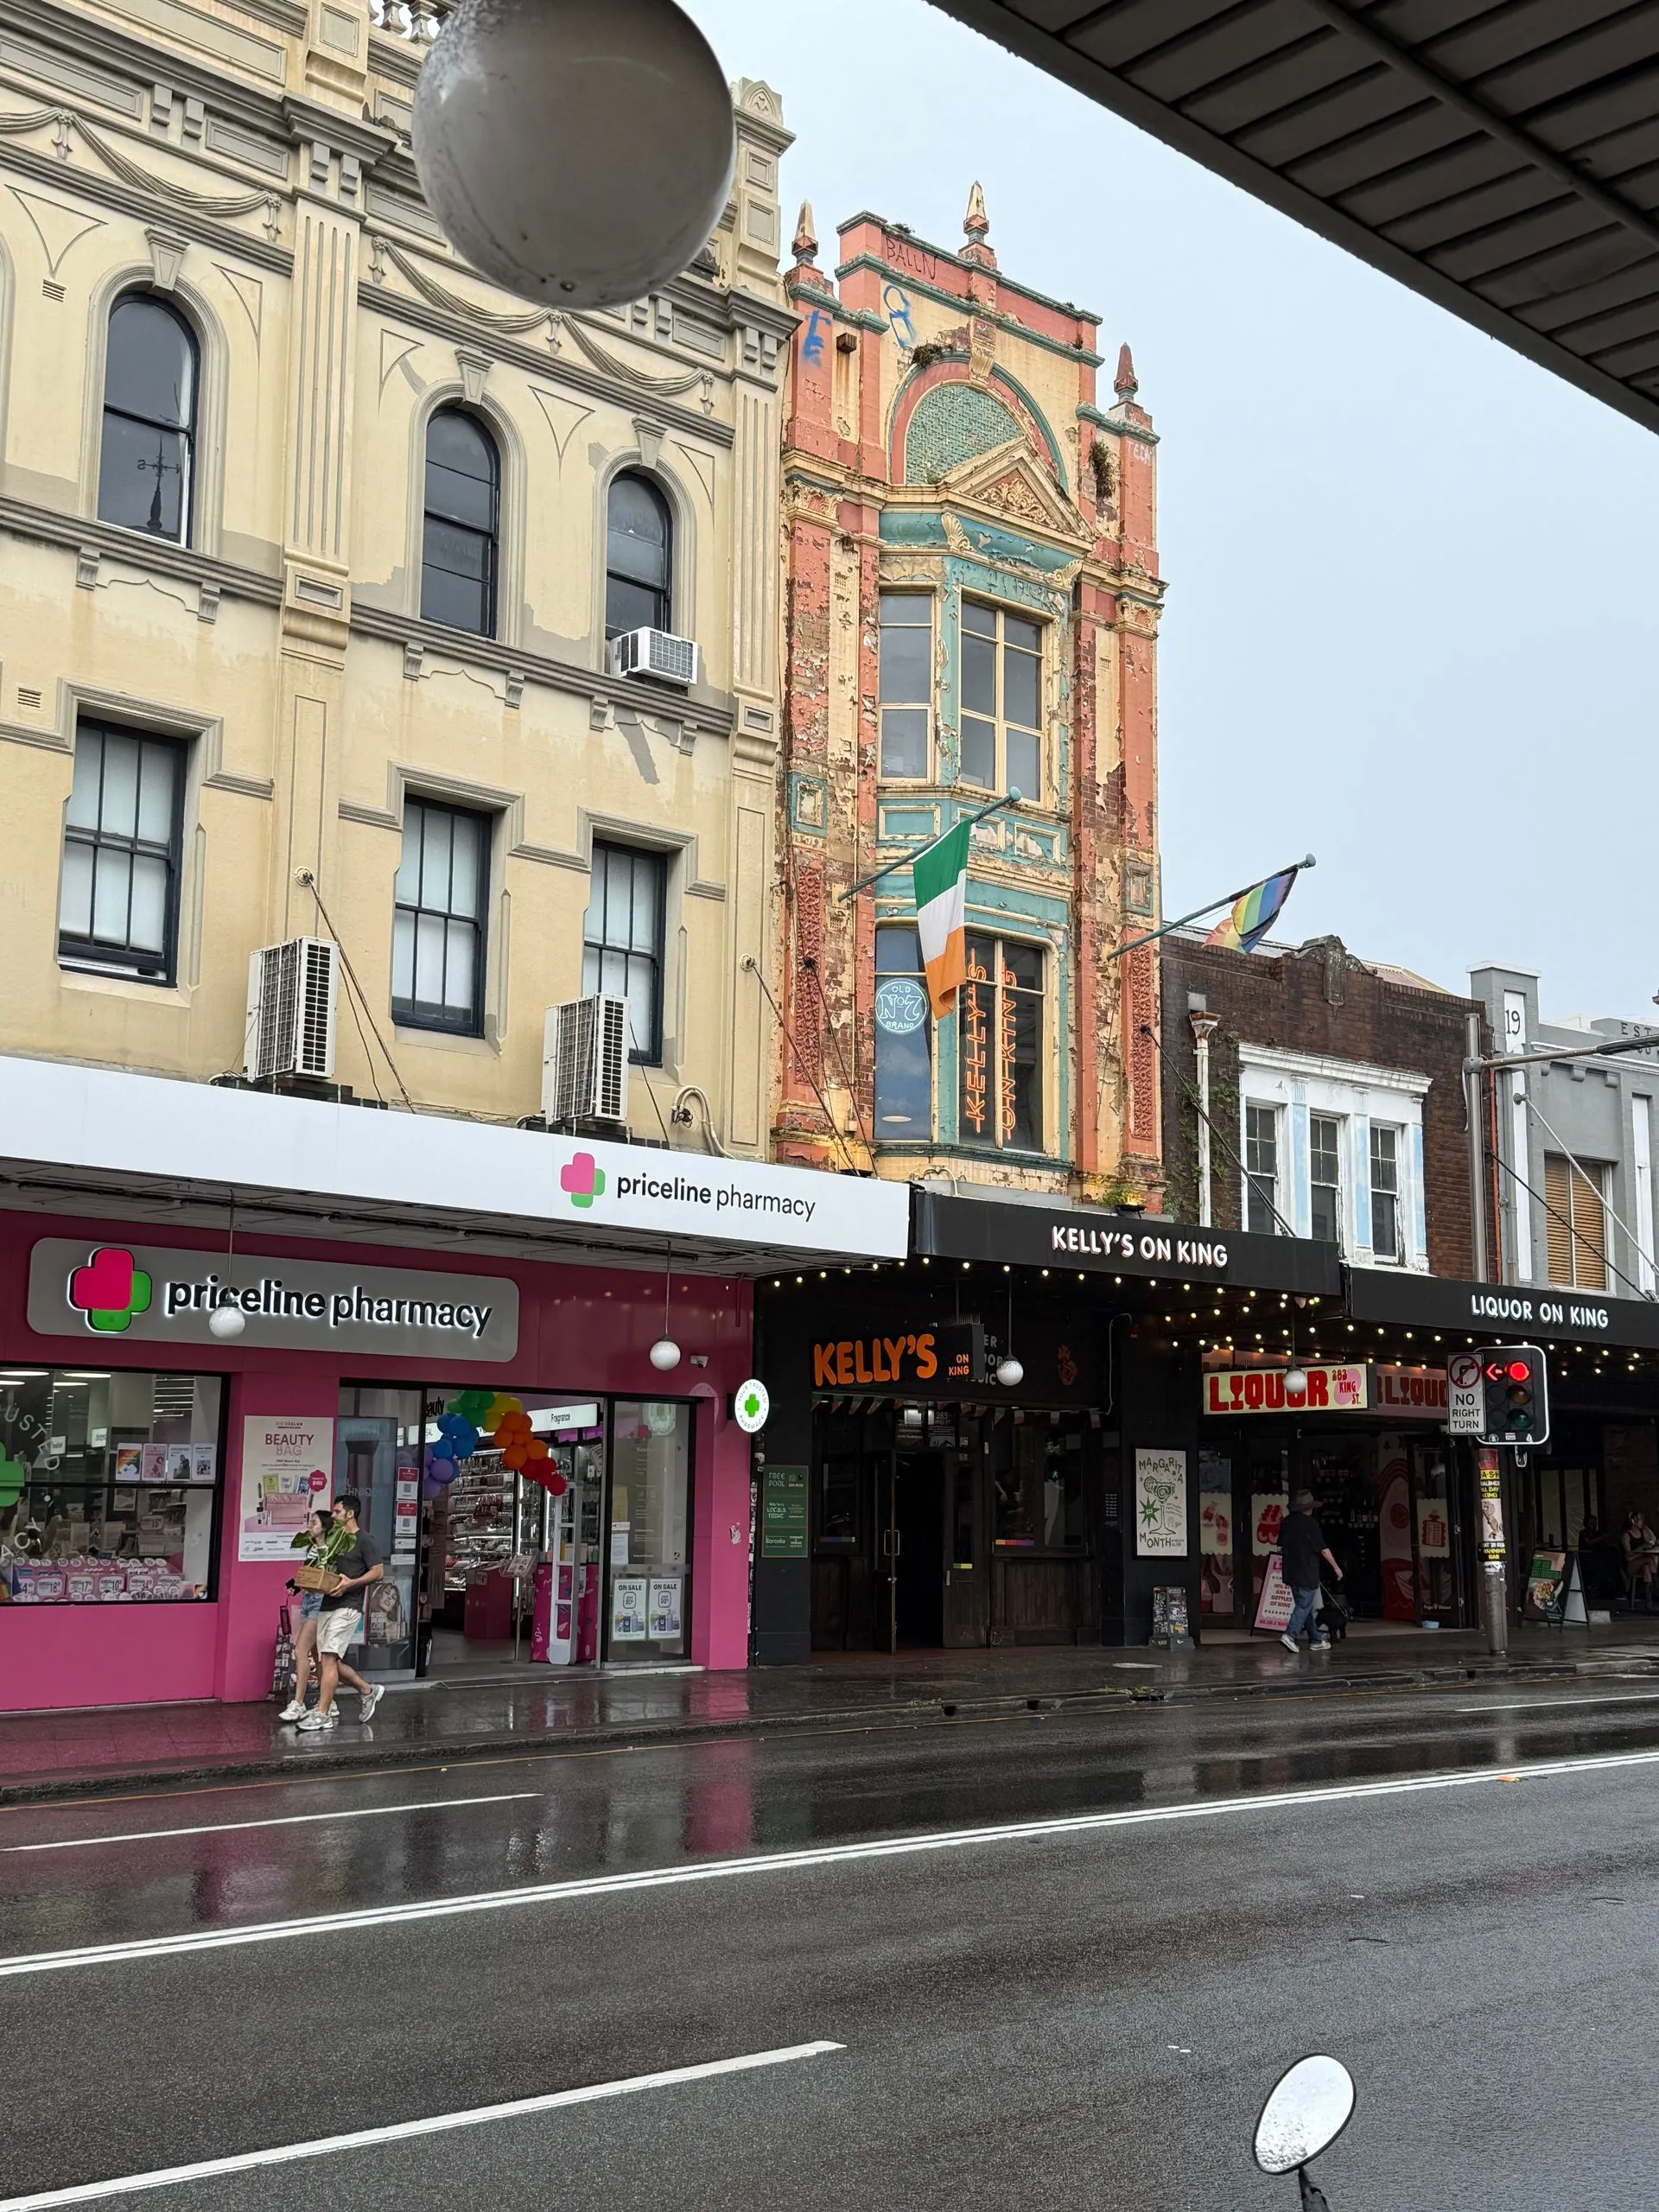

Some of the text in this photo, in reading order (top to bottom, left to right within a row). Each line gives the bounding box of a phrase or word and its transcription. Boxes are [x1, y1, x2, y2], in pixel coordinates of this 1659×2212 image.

[886, 1020, 914, 1029] BRAND
[1504, 1009, 1521, 1035] 19
[617, 1172, 817, 1223] priceline pharmacy
[1052, 1224, 1228, 1268] KELLY'S ON KING
[331, 1285, 493, 1338] pharmacy
[1471, 1294, 1611, 1331] LIQUOR ON KING
[814, 1333, 938, 1387] KELLY'S
[956, 1353, 969, 1364] ON
[949, 1365, 969, 1376] KING
[1332, 1369, 1347, 1382] 283
[1339, 1381, 1357, 1394] KING
[1455, 1394, 1475, 1406] NO
[1452, 1408, 1481, 1418] RIGHT
[1452, 1421, 1479, 1429] TURN
[264, 1433, 315, 1446] BEAUTY
[276, 1445, 302, 1456] BAG
[1138, 1457, 1184, 1484] MARGARITA
[1139, 1531, 1172, 1549] MONTH
